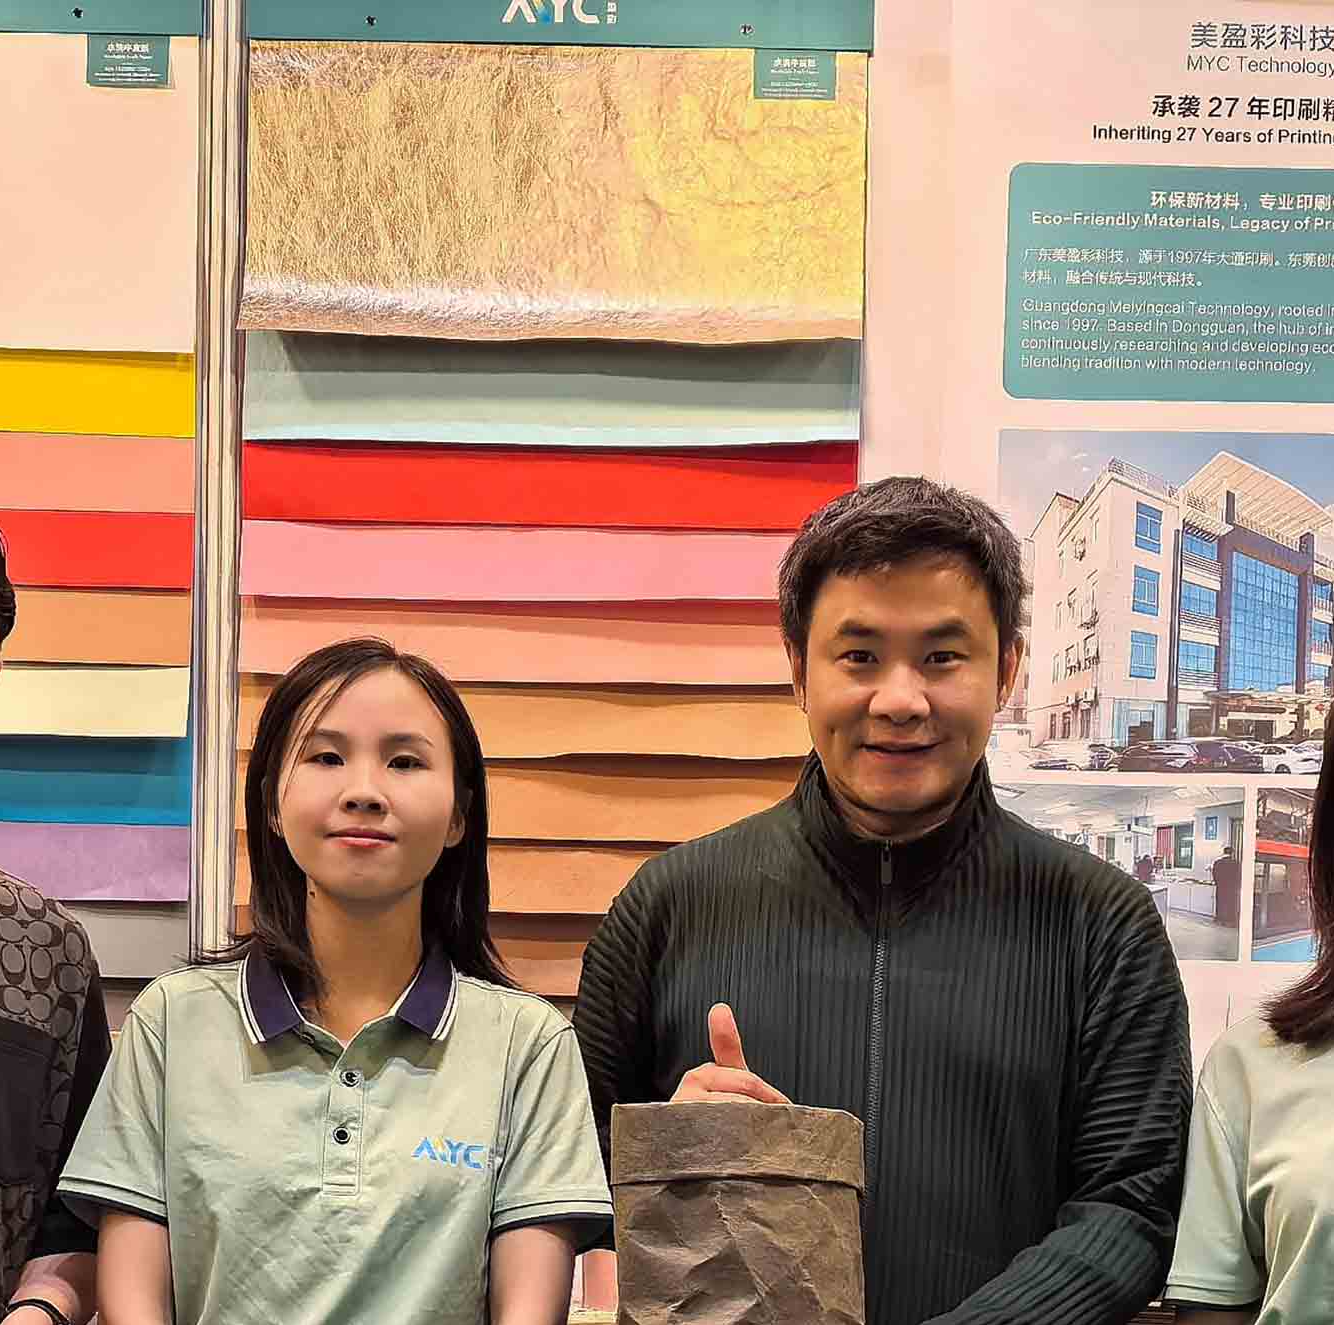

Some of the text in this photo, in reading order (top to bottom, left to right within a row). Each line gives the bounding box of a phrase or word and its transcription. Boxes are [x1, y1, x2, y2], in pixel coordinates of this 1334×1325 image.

[1186, 55, 1230, 72] MYC
[1151, 94, 1201, 119] 承袭
[1208, 97, 1240, 118] 27
[1092, 125, 1172, 144] Inheriting
[1176, 127, 1197, 142] 27
[1203, 127, 1252, 144] Years
[1257, 129, 1274, 144] of
[1030, 211, 1141, 230] Eco-Friendly
[1144, 213, 1226, 231] Materials,
[1230, 215, 1290, 233] Legacy
[1294, 216, 1311, 231] of
[1021, 299, 1107, 315] Guangdong
[1278, 303, 1324, 317] rooted
[1021, 318, 1060, 331] since
[1107, 319, 1153, 332] Based
[1156, 320, 1168, 332] in
[1172, 320, 1250, 336] Dongguan,
[1253, 321, 1276, 334] the
[1279, 321, 1305, 335] hub
[1308, 322, 1324, 335] of
[1020, 337, 1111, 353] continuously
[1114, 338, 1199, 354] researching
[1202, 338, 1228, 353] and
[1232, 339, 1309, 356] developing
[1020, 354, 1080, 371] blending
[1084, 355, 1142, 369] tradition
[1145, 356, 1173, 370] with
[1177, 357, 1231, 371] modern
